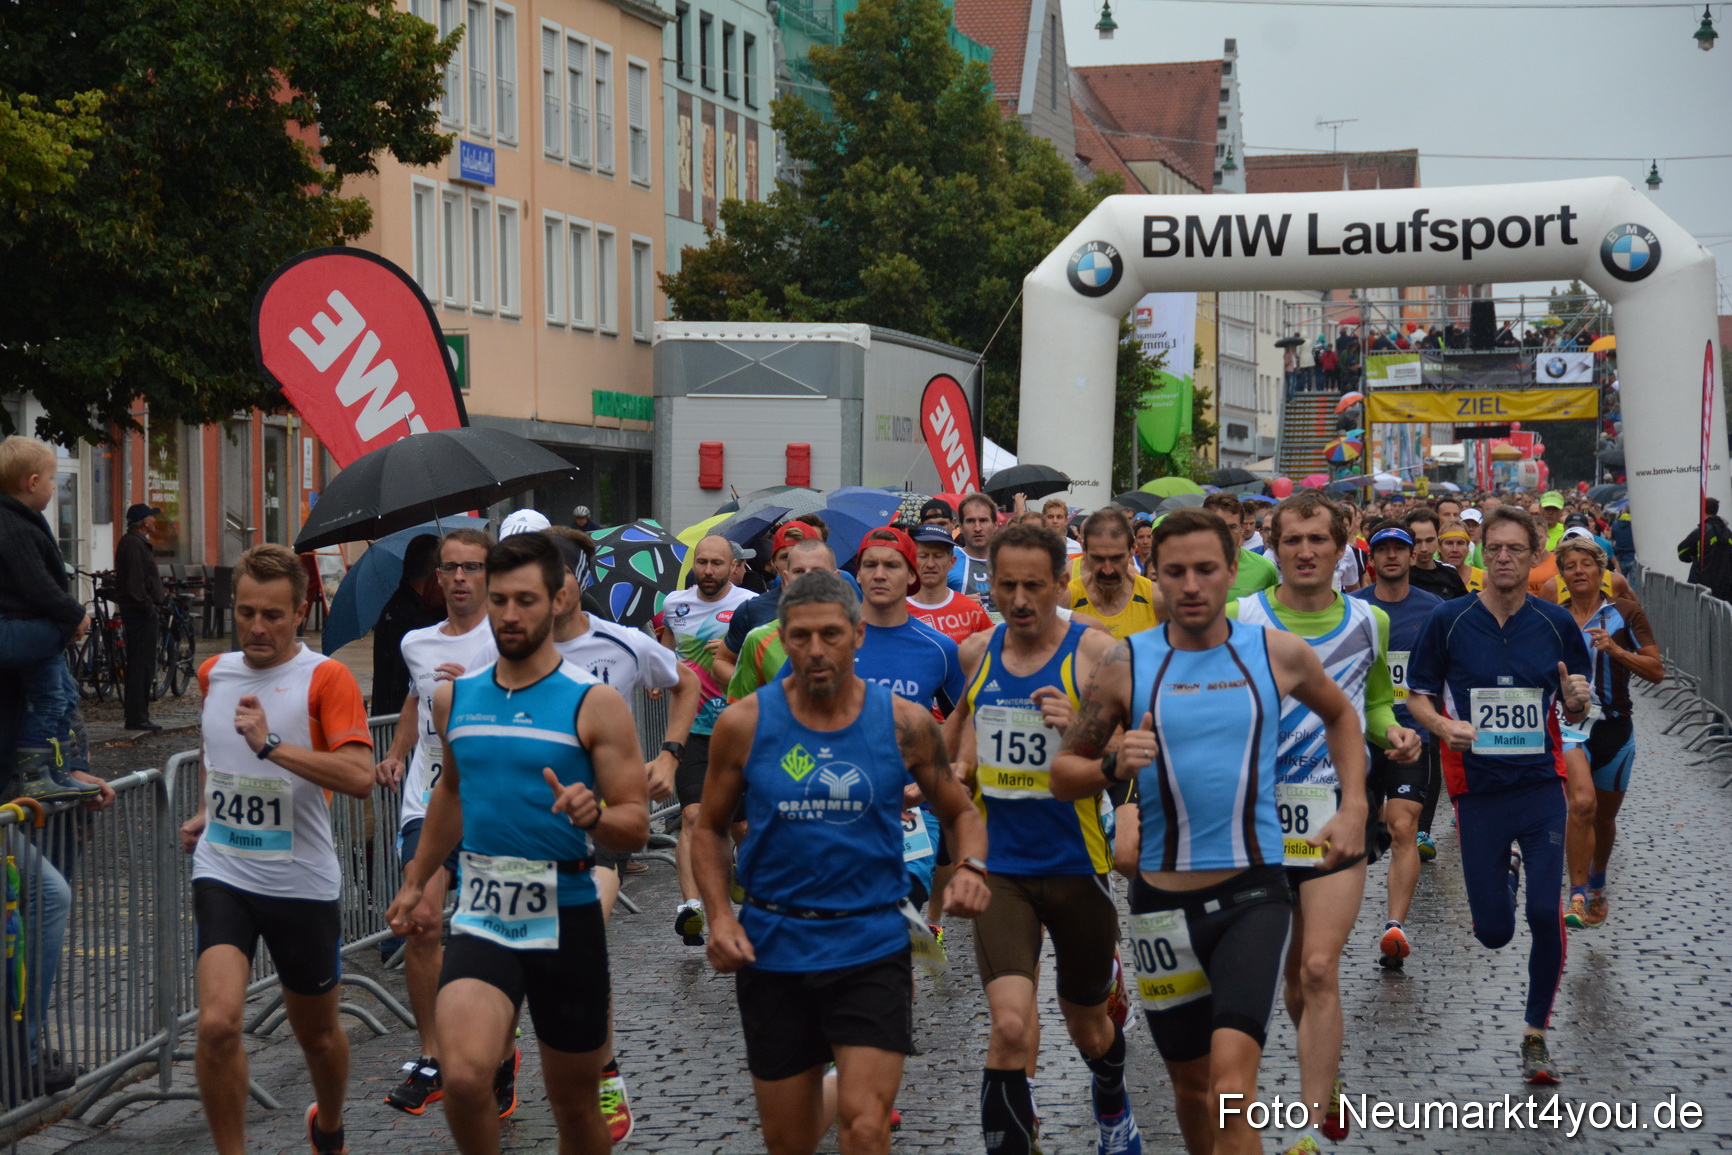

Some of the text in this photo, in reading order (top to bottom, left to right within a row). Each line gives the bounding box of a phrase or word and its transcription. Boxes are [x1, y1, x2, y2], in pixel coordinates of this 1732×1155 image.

[1143, 205, 1578, 260] BMW Laufsport
[1606, 224, 1657, 245] BMW
[1071, 241, 1117, 264] BMW
[1457, 397, 1508, 416] ZIEL
[1070, 479, 1099, 487] sport.de
[1479, 704, 1538, 729] 2580
[991, 730, 1046, 766] 153
[1494, 735, 1525, 745] Martin
[997, 773, 1034, 787] Mario
[1287, 787, 1328, 797] BOCK
[212, 790, 281, 826] 2481
[778, 800, 862, 811] GRAMMER
[229, 831, 262, 847] Armin
[1283, 843, 1315, 855] ristian
[470, 878, 547, 915] 2673
